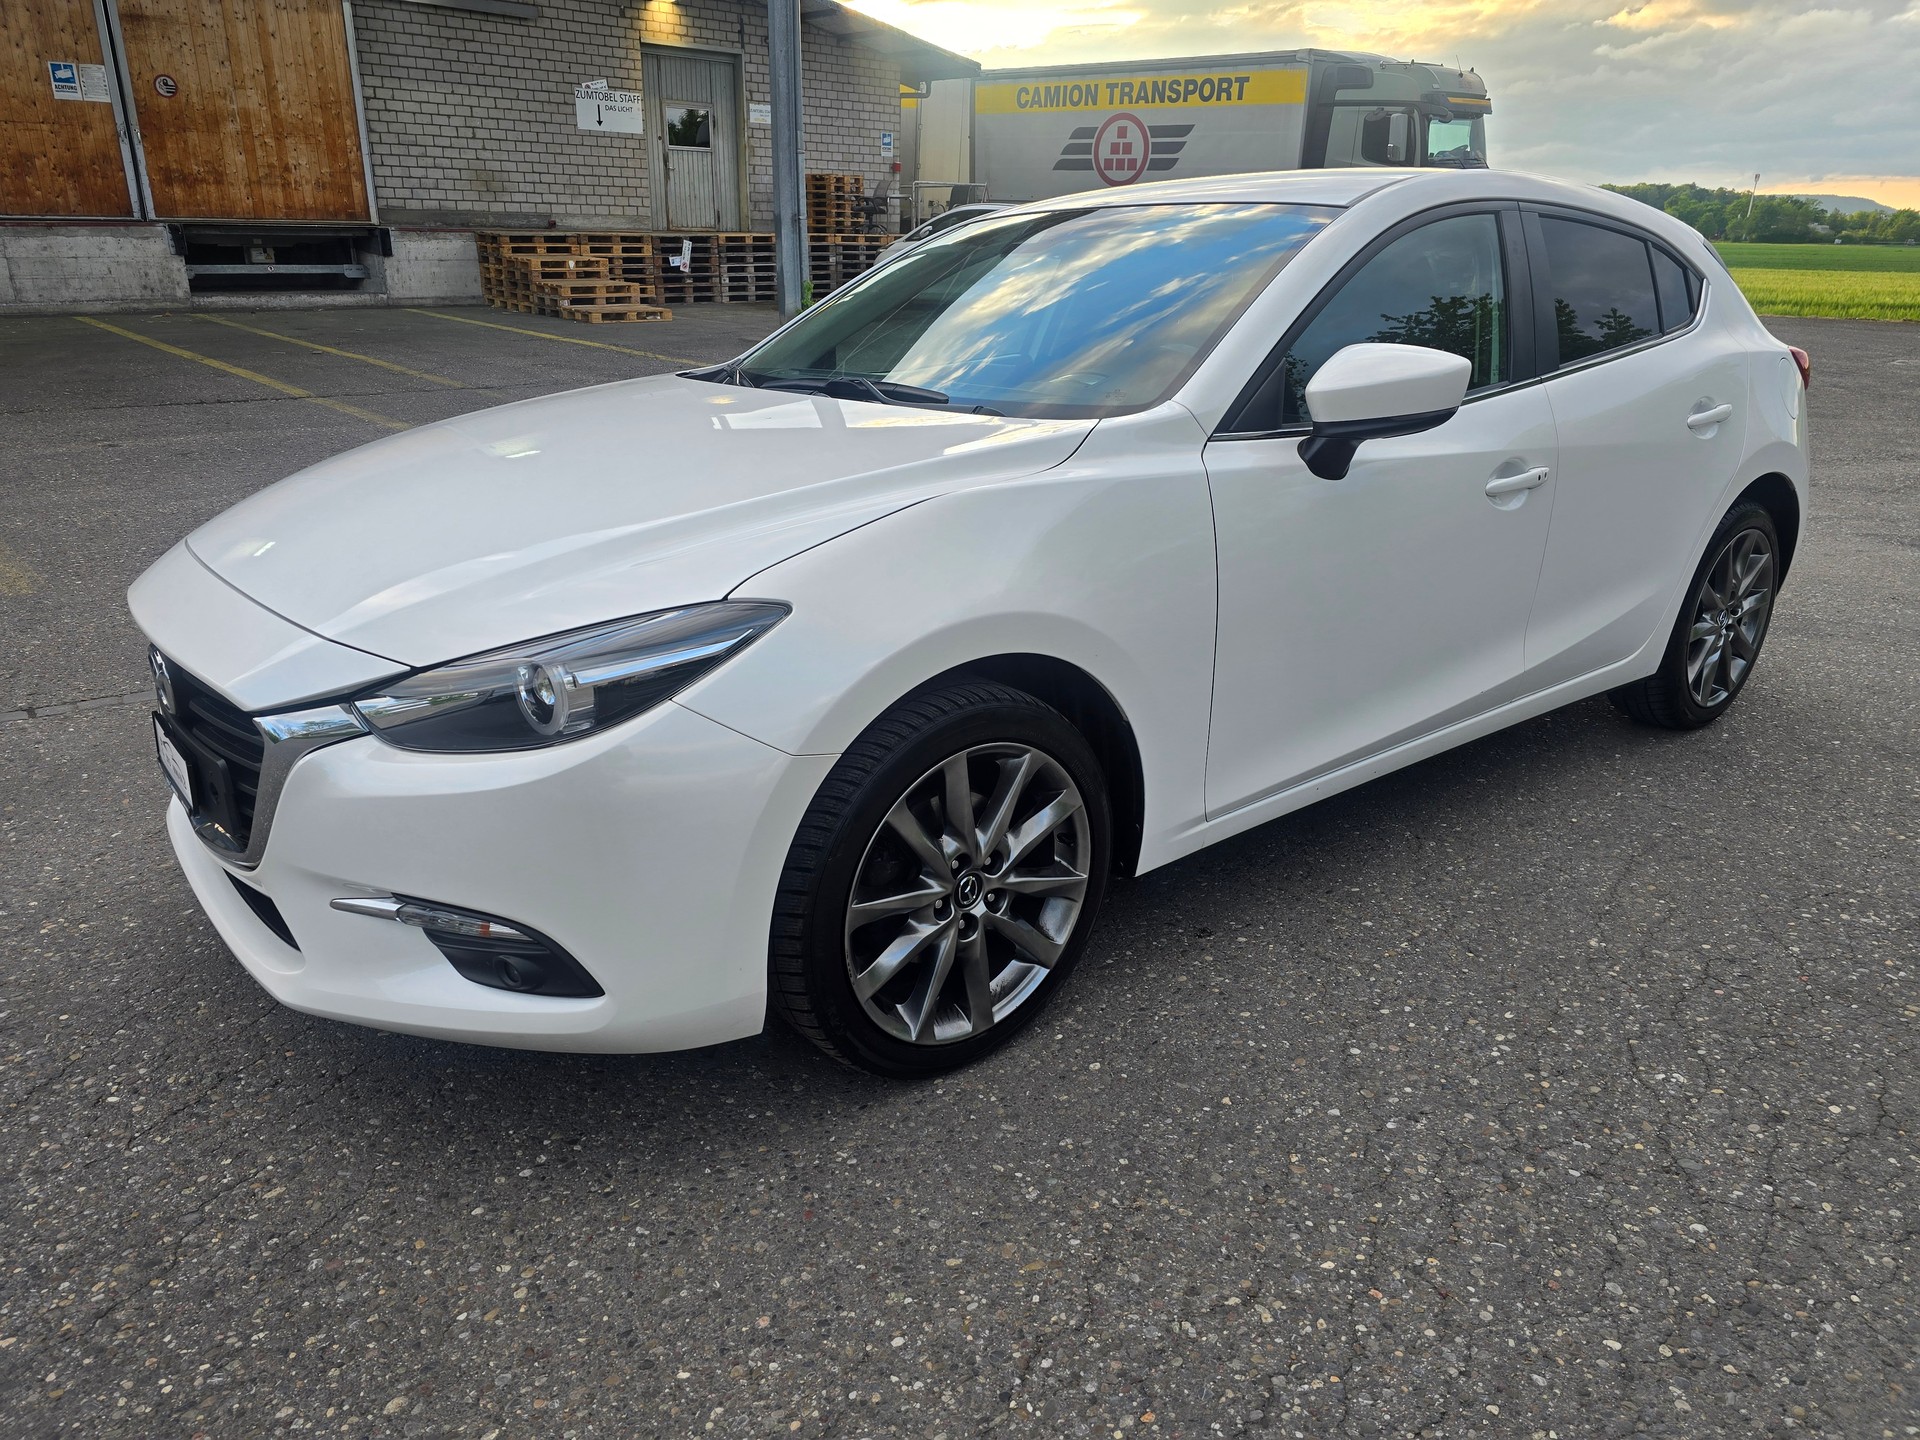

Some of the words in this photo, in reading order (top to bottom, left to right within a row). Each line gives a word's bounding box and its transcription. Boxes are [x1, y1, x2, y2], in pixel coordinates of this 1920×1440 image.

[575, 89, 617, 102] ZUMTOBEL
[619, 93, 641, 104] STAFF
[1016, 83, 1099, 109] CAMION
[1105, 76, 1251, 105] TRANSPORT
[605, 104, 616, 112] DAS
[617, 105, 633, 113] LICHT
